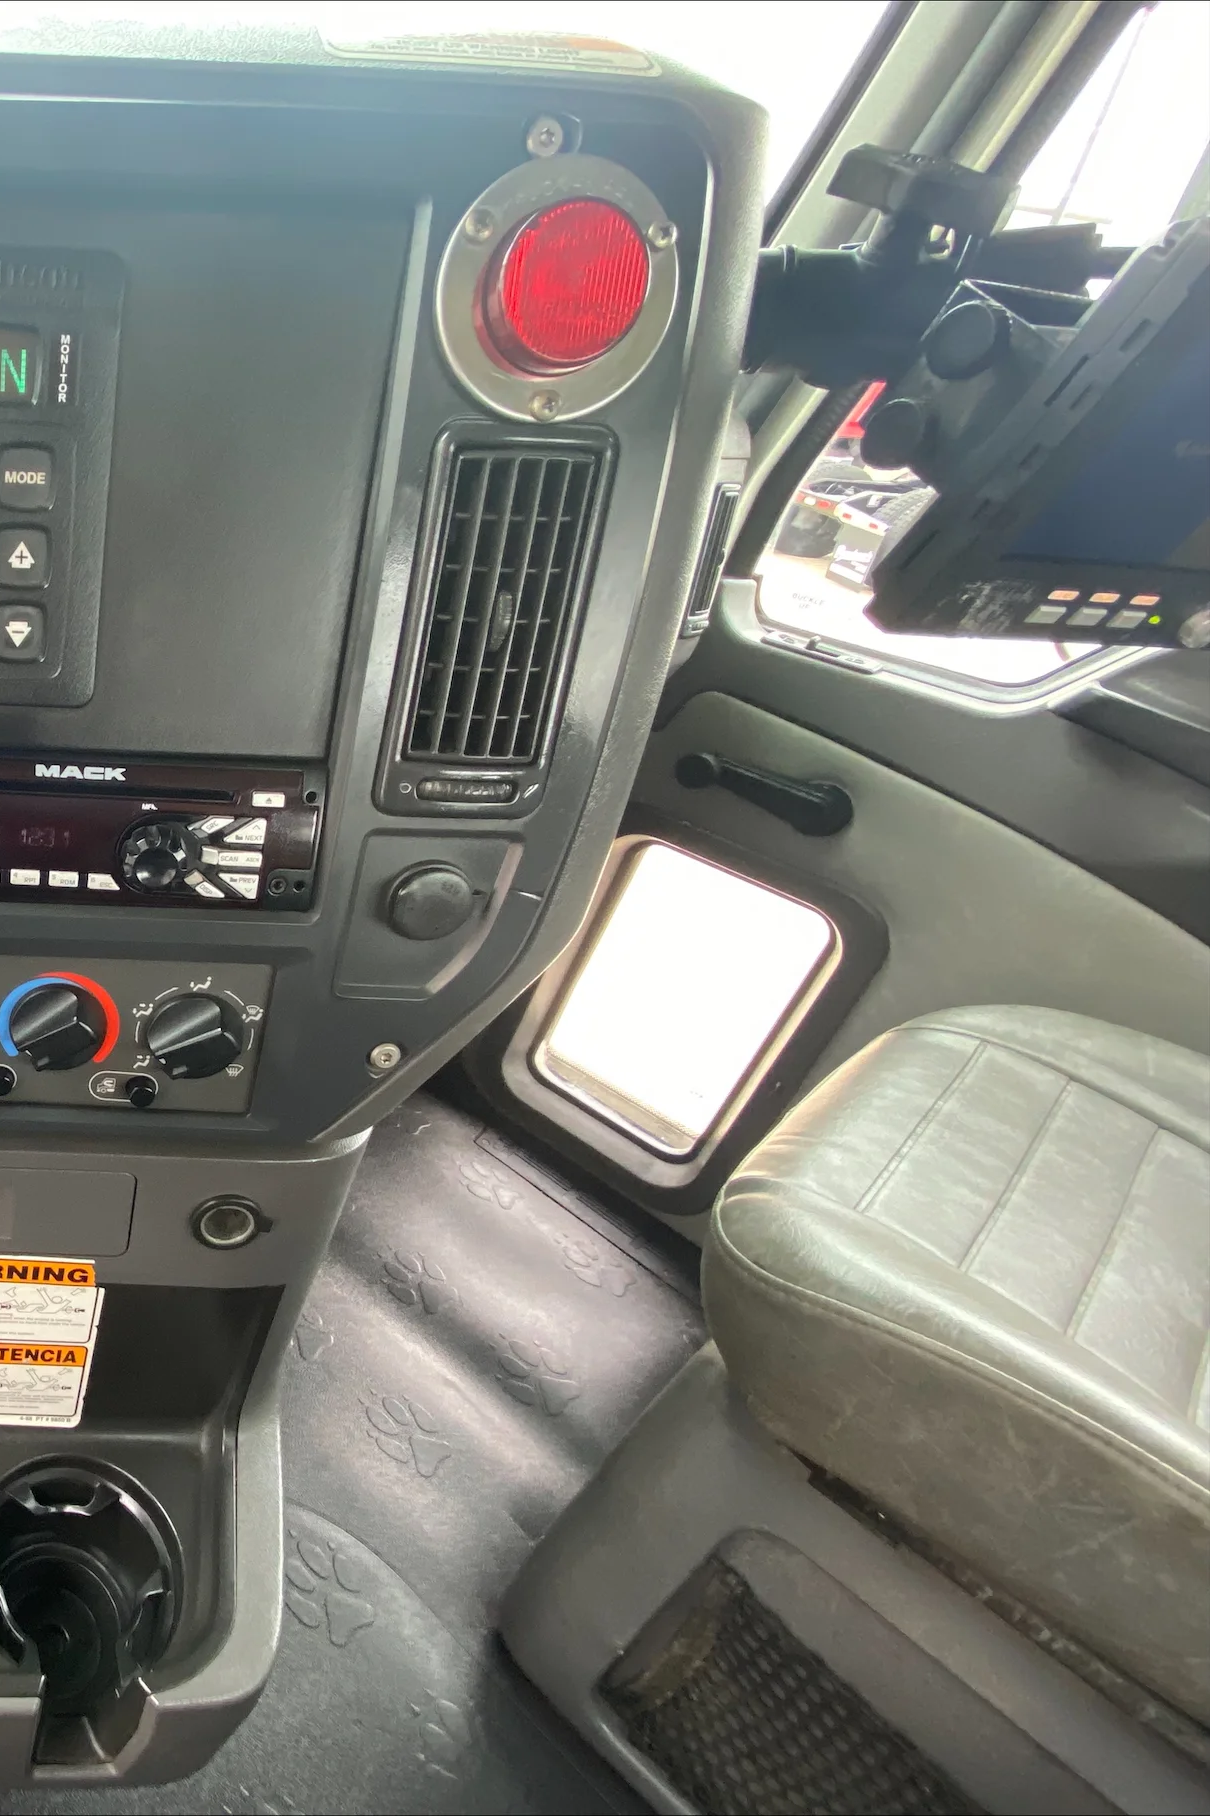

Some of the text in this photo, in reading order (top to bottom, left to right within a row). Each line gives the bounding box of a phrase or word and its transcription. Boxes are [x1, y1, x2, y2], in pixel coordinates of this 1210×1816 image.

[0, 348, 27, 393] N
[58, 334, 71, 402] MONITOR
[4, 471, 46, 485] MODE
[34, 763, 127, 782] MACK
